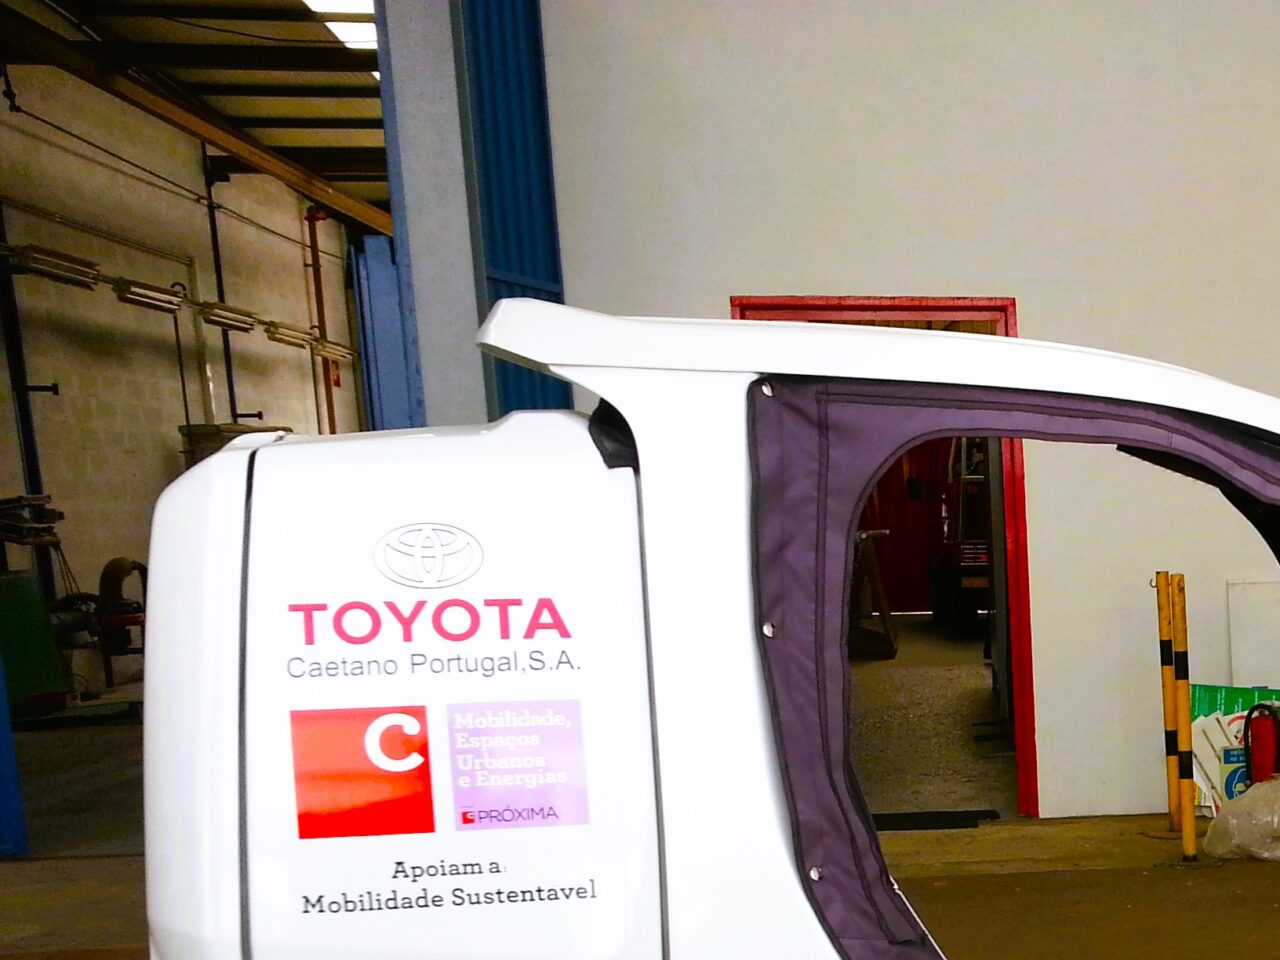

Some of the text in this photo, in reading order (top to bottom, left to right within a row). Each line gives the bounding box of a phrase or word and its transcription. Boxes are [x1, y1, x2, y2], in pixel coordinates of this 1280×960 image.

[288, 598, 572, 646] TOYOTA
[287, 657, 398, 678] Caetano
[453, 708, 572, 729] Mobilidade,
[364, 713, 426, 772] C
[455, 732, 541, 752] Espaços
[456, 752, 545, 770] Urbanos
[458, 768, 568, 789] e Energias
[478, 805, 559, 823] PRÓXIMA
[392, 860, 483, 882] Apoiam
[302, 879, 597, 914] Mobilidade Sustentavel
